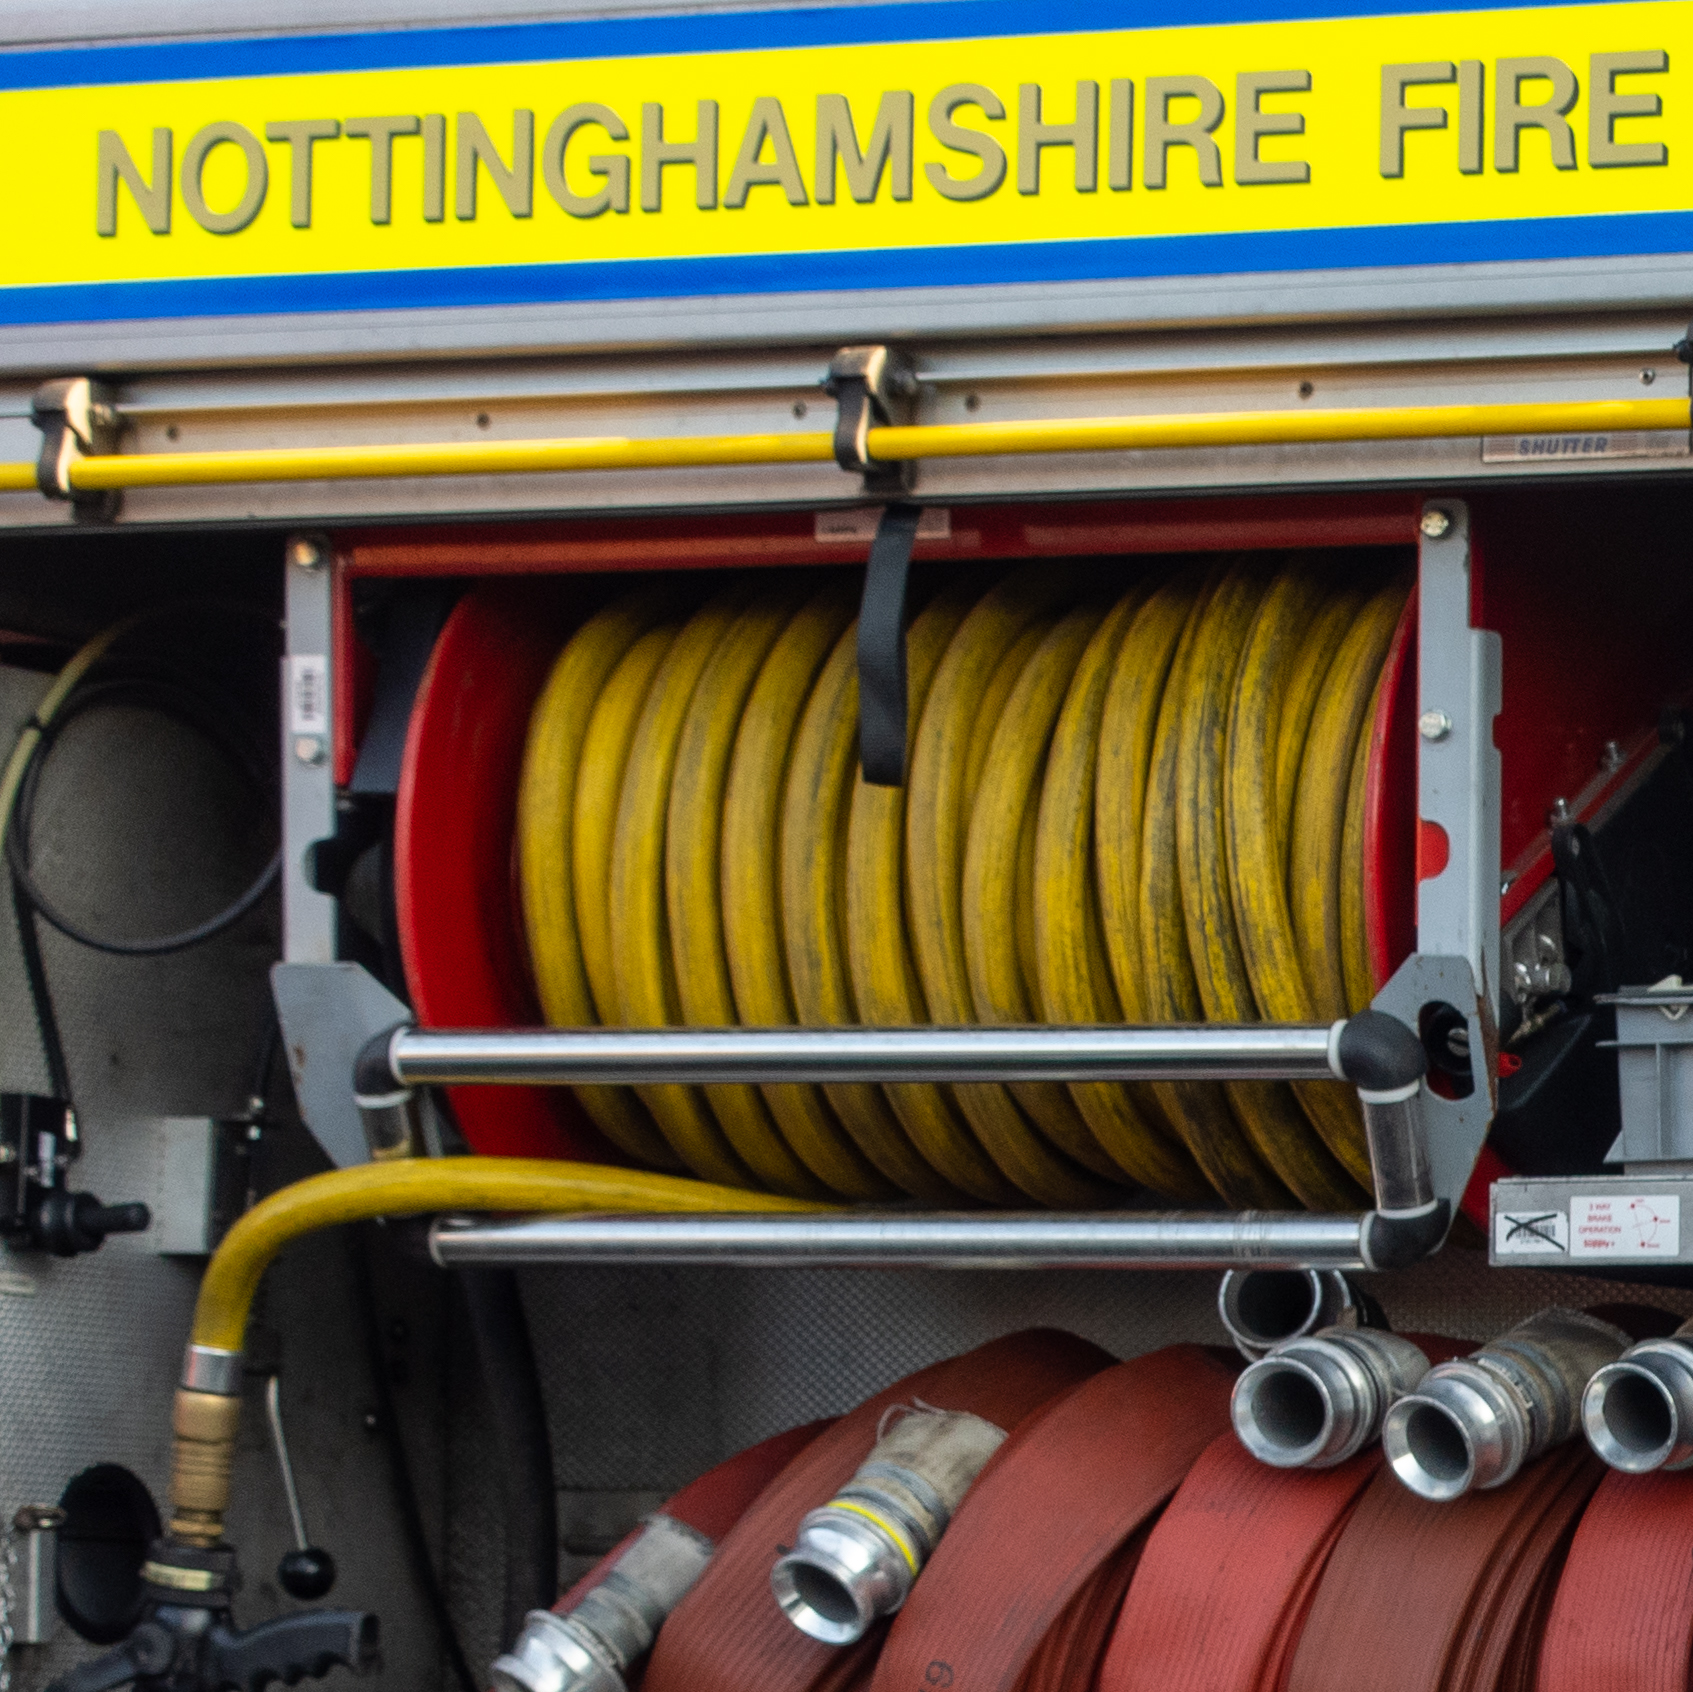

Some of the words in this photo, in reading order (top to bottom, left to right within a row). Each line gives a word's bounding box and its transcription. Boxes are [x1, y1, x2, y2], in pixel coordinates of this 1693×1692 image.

[95, 68, 1312, 238] NOTTINGHAMSHIRE
[1378, 48, 1669, 179] FIRE
[1518, 436, 1609, 455] SHUTTER
